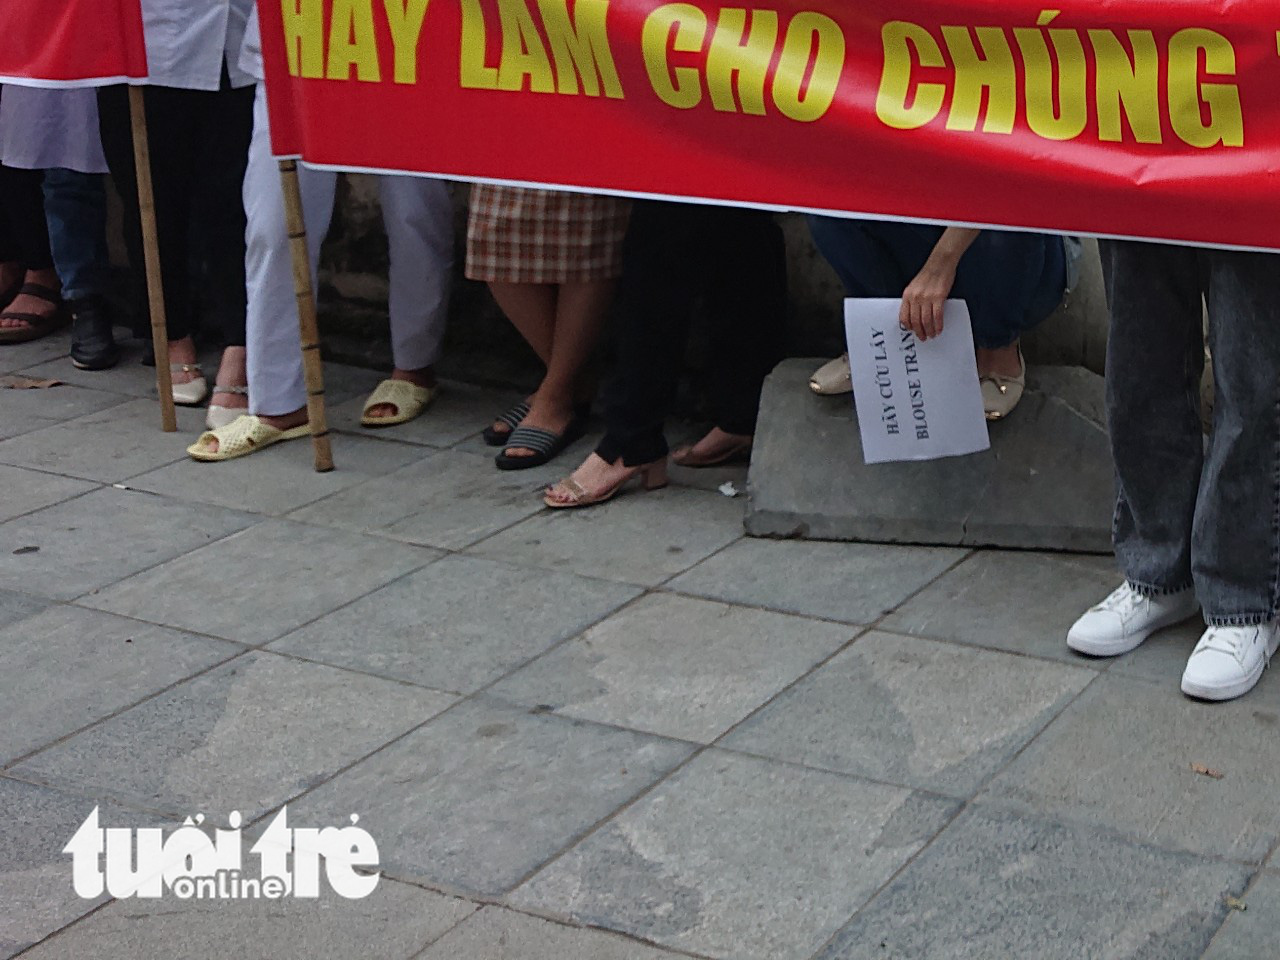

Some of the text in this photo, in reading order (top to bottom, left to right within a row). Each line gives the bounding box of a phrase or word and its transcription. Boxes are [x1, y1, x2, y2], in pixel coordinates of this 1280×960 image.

[641, 2, 847, 122] CHO
[874, 9, 1244, 149] CHÚNG
[874, 364, 894, 400] CỨU
[881, 403, 901, 436] HÃY
[909, 379, 930, 441] BLOUSE
